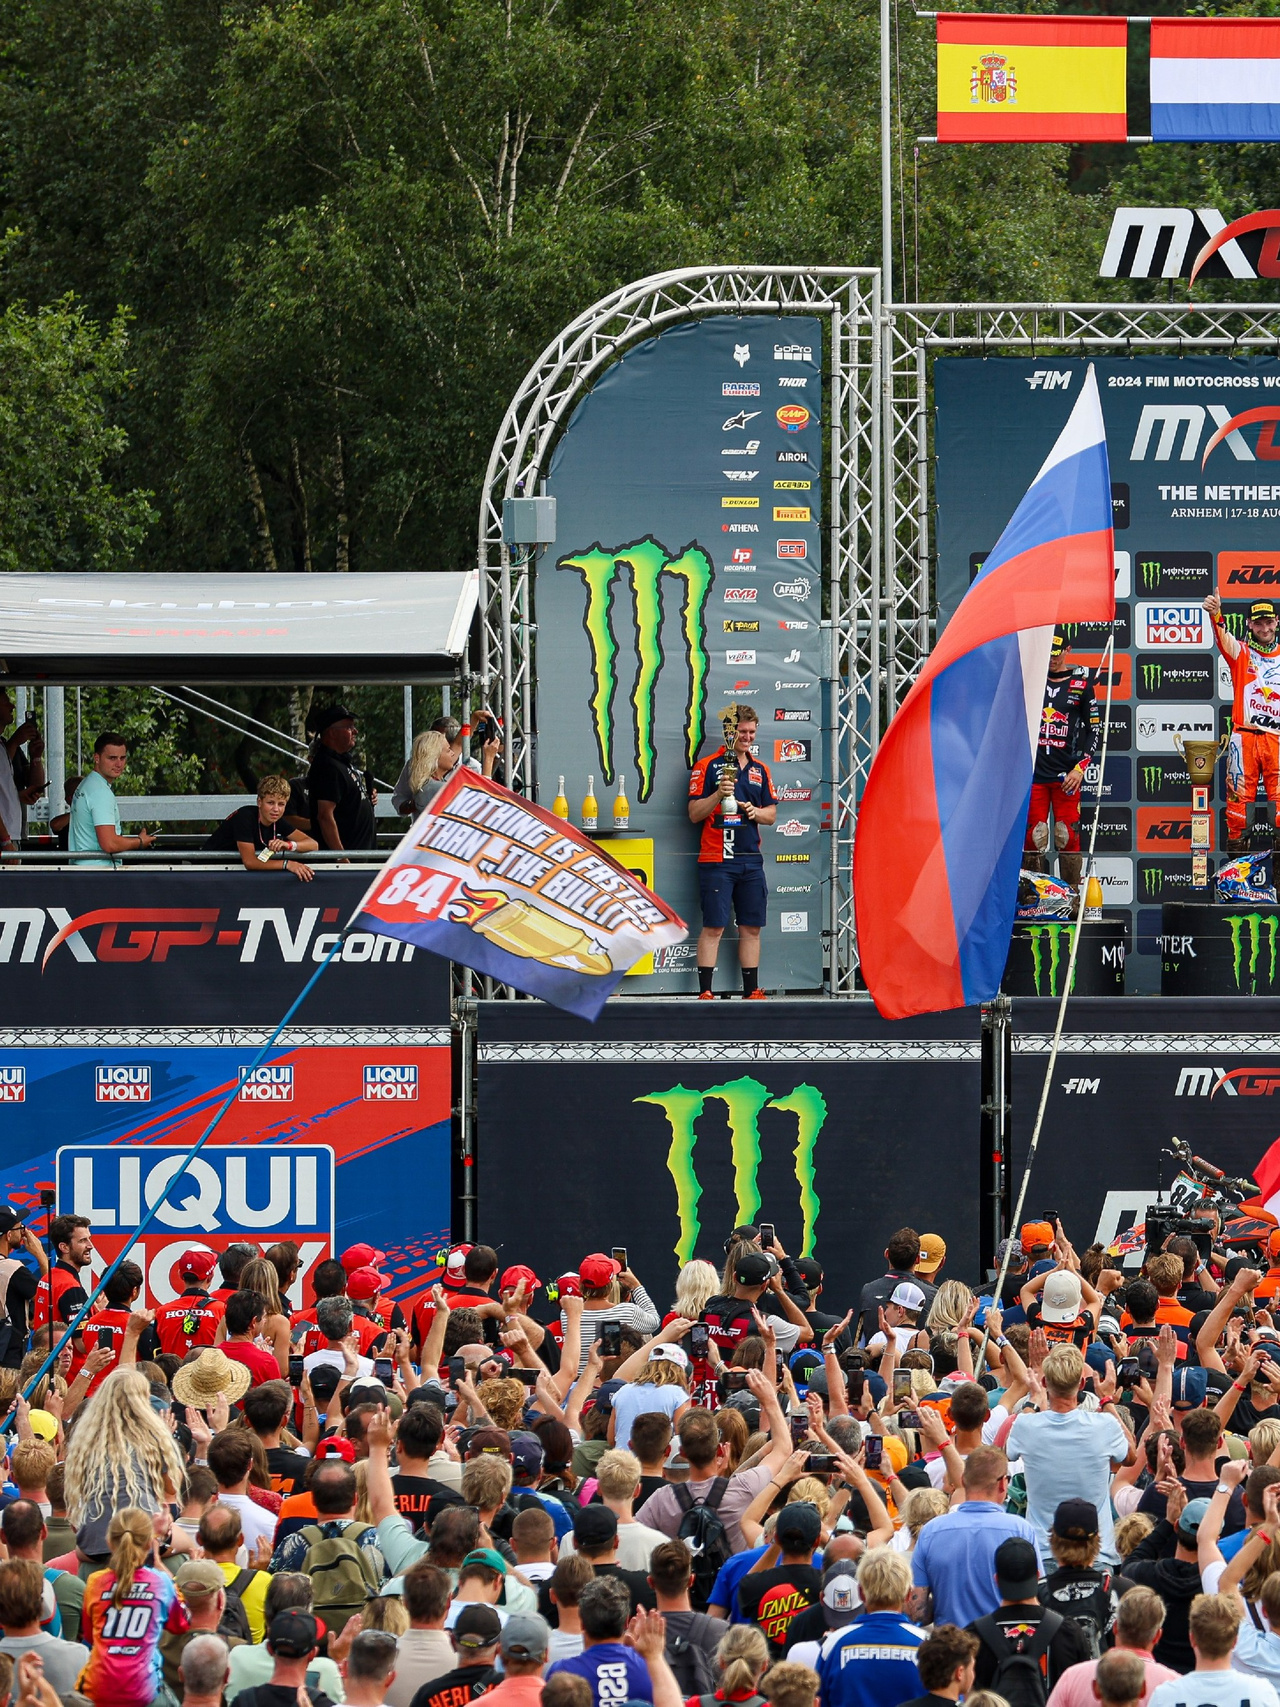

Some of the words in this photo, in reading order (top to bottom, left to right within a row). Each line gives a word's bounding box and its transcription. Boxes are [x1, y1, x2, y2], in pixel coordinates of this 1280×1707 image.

[773, 344, 812, 353] GoPro
[723, 383, 760, 391] PARTS
[1028, 370, 1072, 390] FIM
[1108, 376, 1142, 388] 2024
[1145, 376, 1170, 388] FIM
[1174, 376, 1260, 388] MOTOCROSS
[778, 453, 808, 462] AIROH
[1158, 485, 1198, 501] THE
[1171, 507, 1223, 519] ARNHEM
[1230, 507, 1259, 519] 17-18
[728, 524, 759, 533] ATHENA
[779, 545, 804, 554] GET
[1162, 565, 1209, 577] MONSTER
[724, 589, 757, 600] KYB
[779, 585, 803, 594] AFAM
[1149, 608, 1200, 625] LIQUI
[1149, 627, 1202, 643] MOLY
[1162, 668, 1210, 679] MONSTER
[1161, 722, 1213, 732] RAM
[1163, 771, 1191, 782] MONS
[418, 817, 492, 861] THAN
[443, 786, 556, 850] NOTHING
[543, 837, 587, 865] IS
[570, 851, 669, 924] FASTER
[378, 867, 454, 914] 84
[98, 1068, 148, 1085] LIQUI
[241, 1067, 291, 1084] LIQUI
[366, 1067, 416, 1083] LIQUI
[97, 1085, 149, 1100] MOLY
[240, 1084, 291, 1100] MOLY
[366, 1083, 416, 1099] MOLY
[1064, 1078, 1101, 1094] FIM
[73, 1154, 318, 1232] LIQUI
[165, 1309, 215, 1319] HONDA
[102, 1606, 152, 1639] 110
